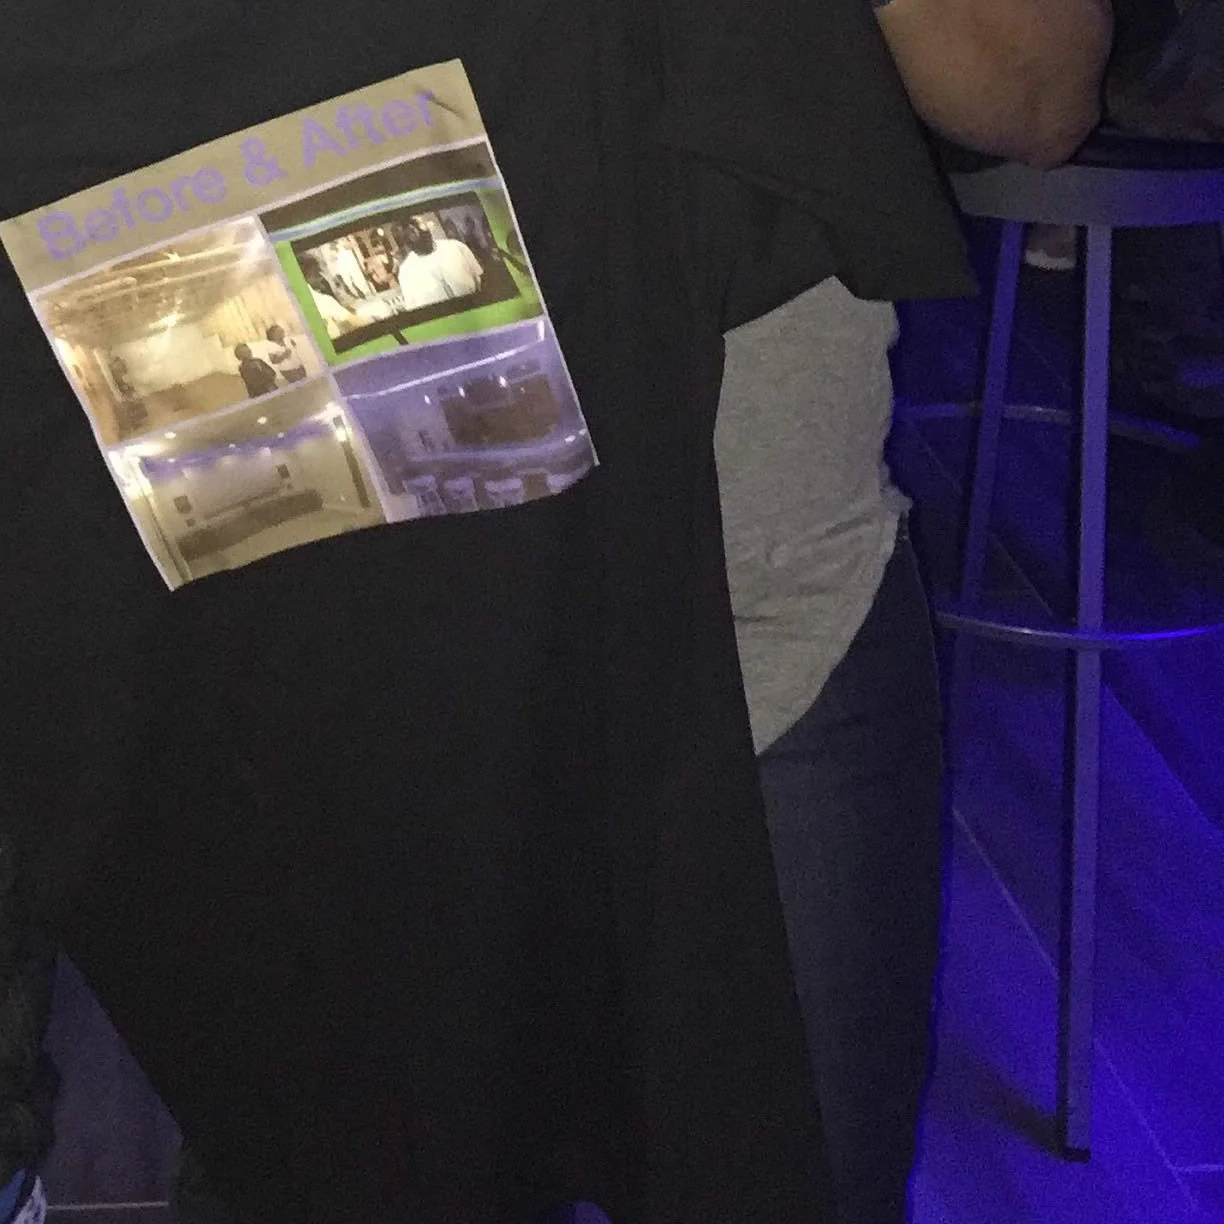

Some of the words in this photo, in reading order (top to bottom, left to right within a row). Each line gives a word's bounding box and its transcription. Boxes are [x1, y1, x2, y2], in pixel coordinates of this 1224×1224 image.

[37, 166, 227, 261] Before
[241, 136, 288, 186] &
[301, 90, 435, 167] After
